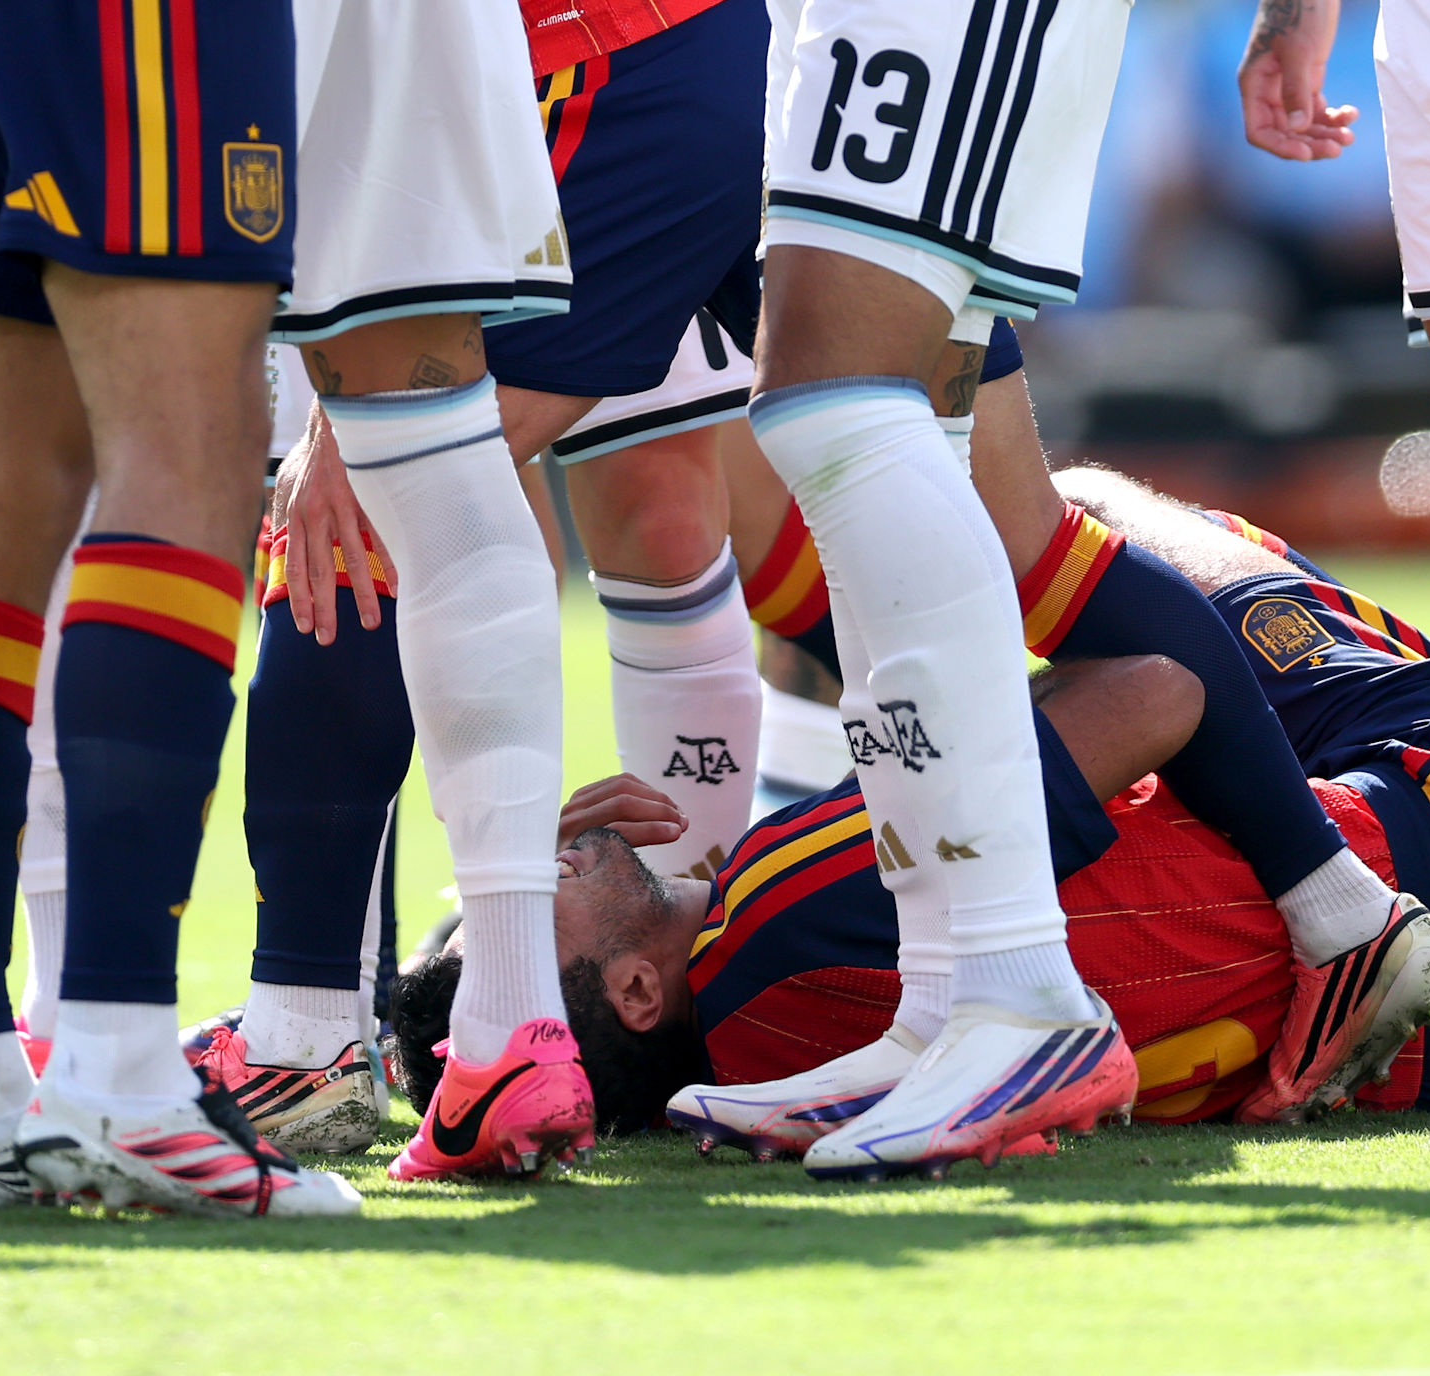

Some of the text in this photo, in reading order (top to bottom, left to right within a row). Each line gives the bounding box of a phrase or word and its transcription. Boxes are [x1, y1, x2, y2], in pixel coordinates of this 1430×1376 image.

[812, 38, 931, 184] 13
[662, 734, 741, 785] AFA
[524, 1021, 567, 1045] Nike
